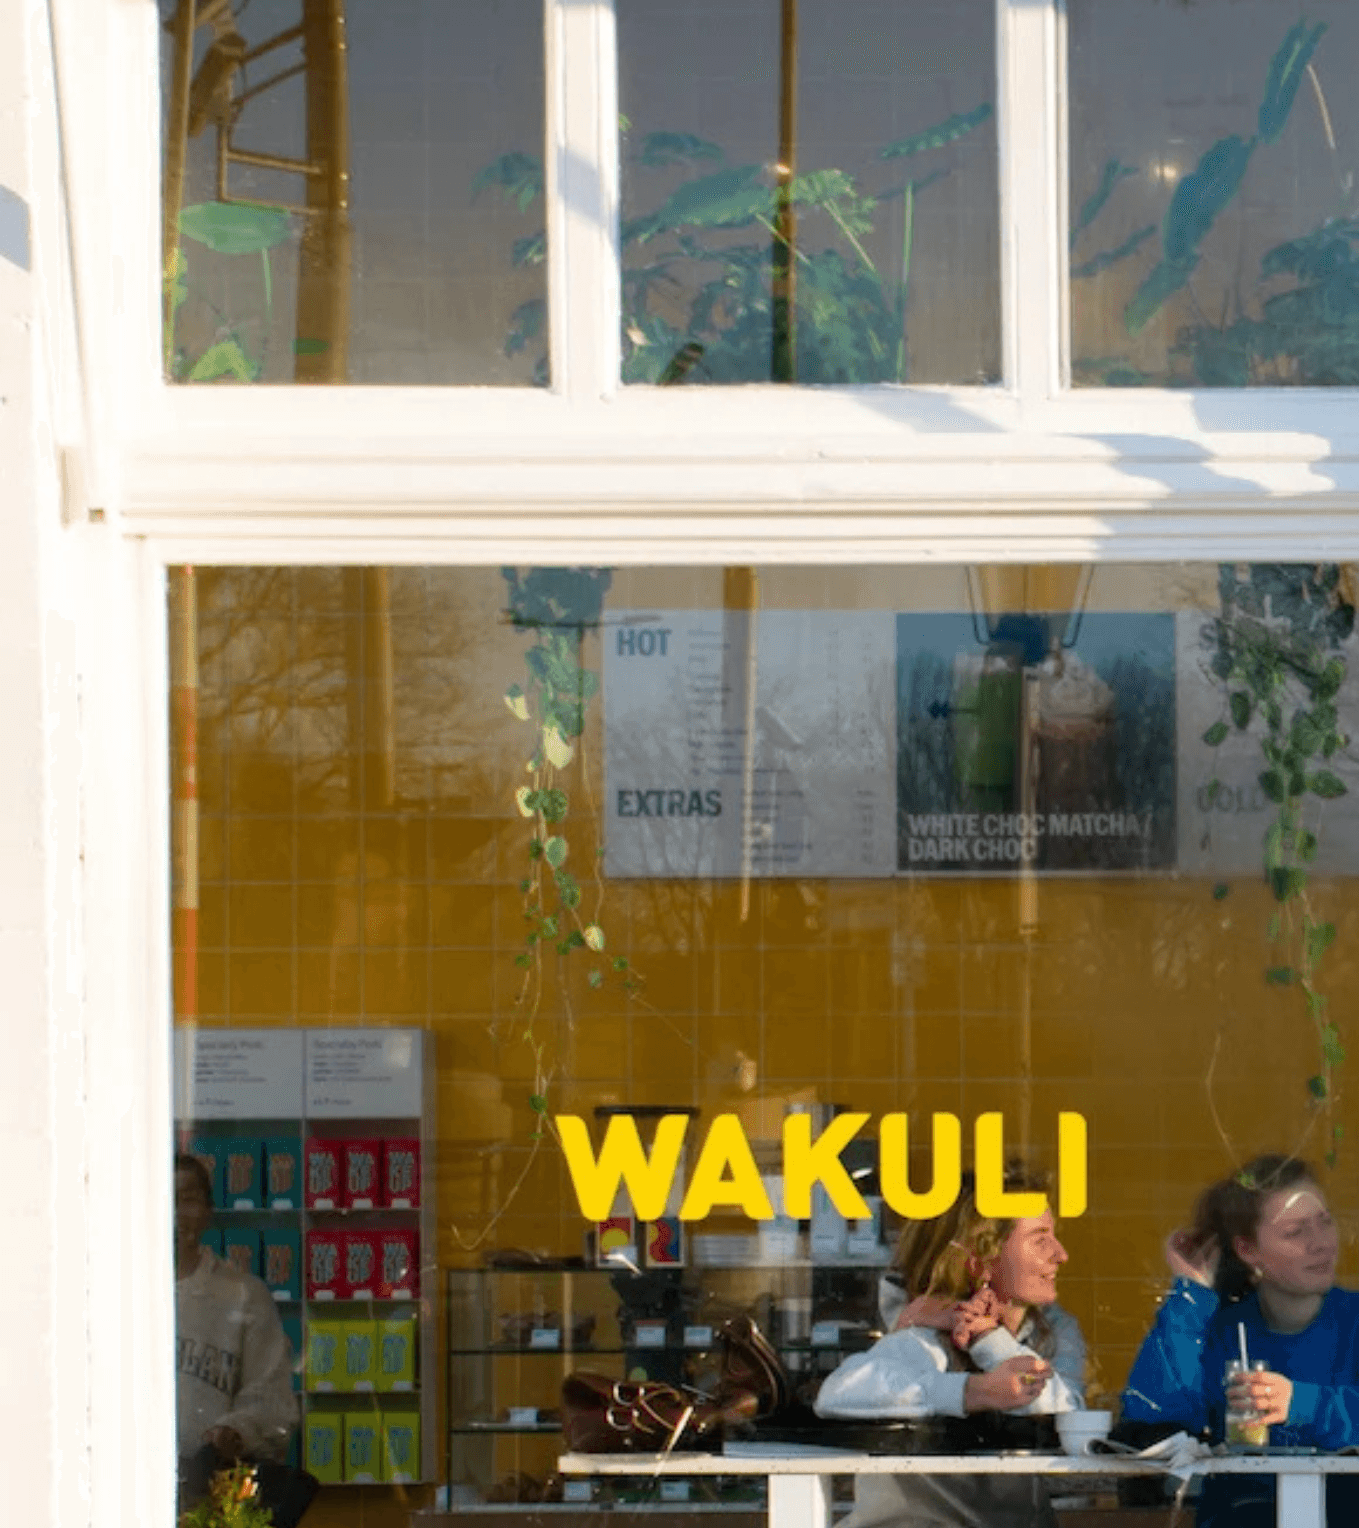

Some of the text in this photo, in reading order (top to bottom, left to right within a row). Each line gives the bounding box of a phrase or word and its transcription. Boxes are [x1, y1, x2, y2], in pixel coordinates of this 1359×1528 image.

[617, 629, 672, 657] HOT
[617, 789, 723, 818] EXTRAS
[908, 813, 980, 836] WHITE
[983, 813, 1046, 836] CHOC
[908, 837, 1037, 861] DARK CHOC
[556, 1112, 1088, 1221] WAKULI
